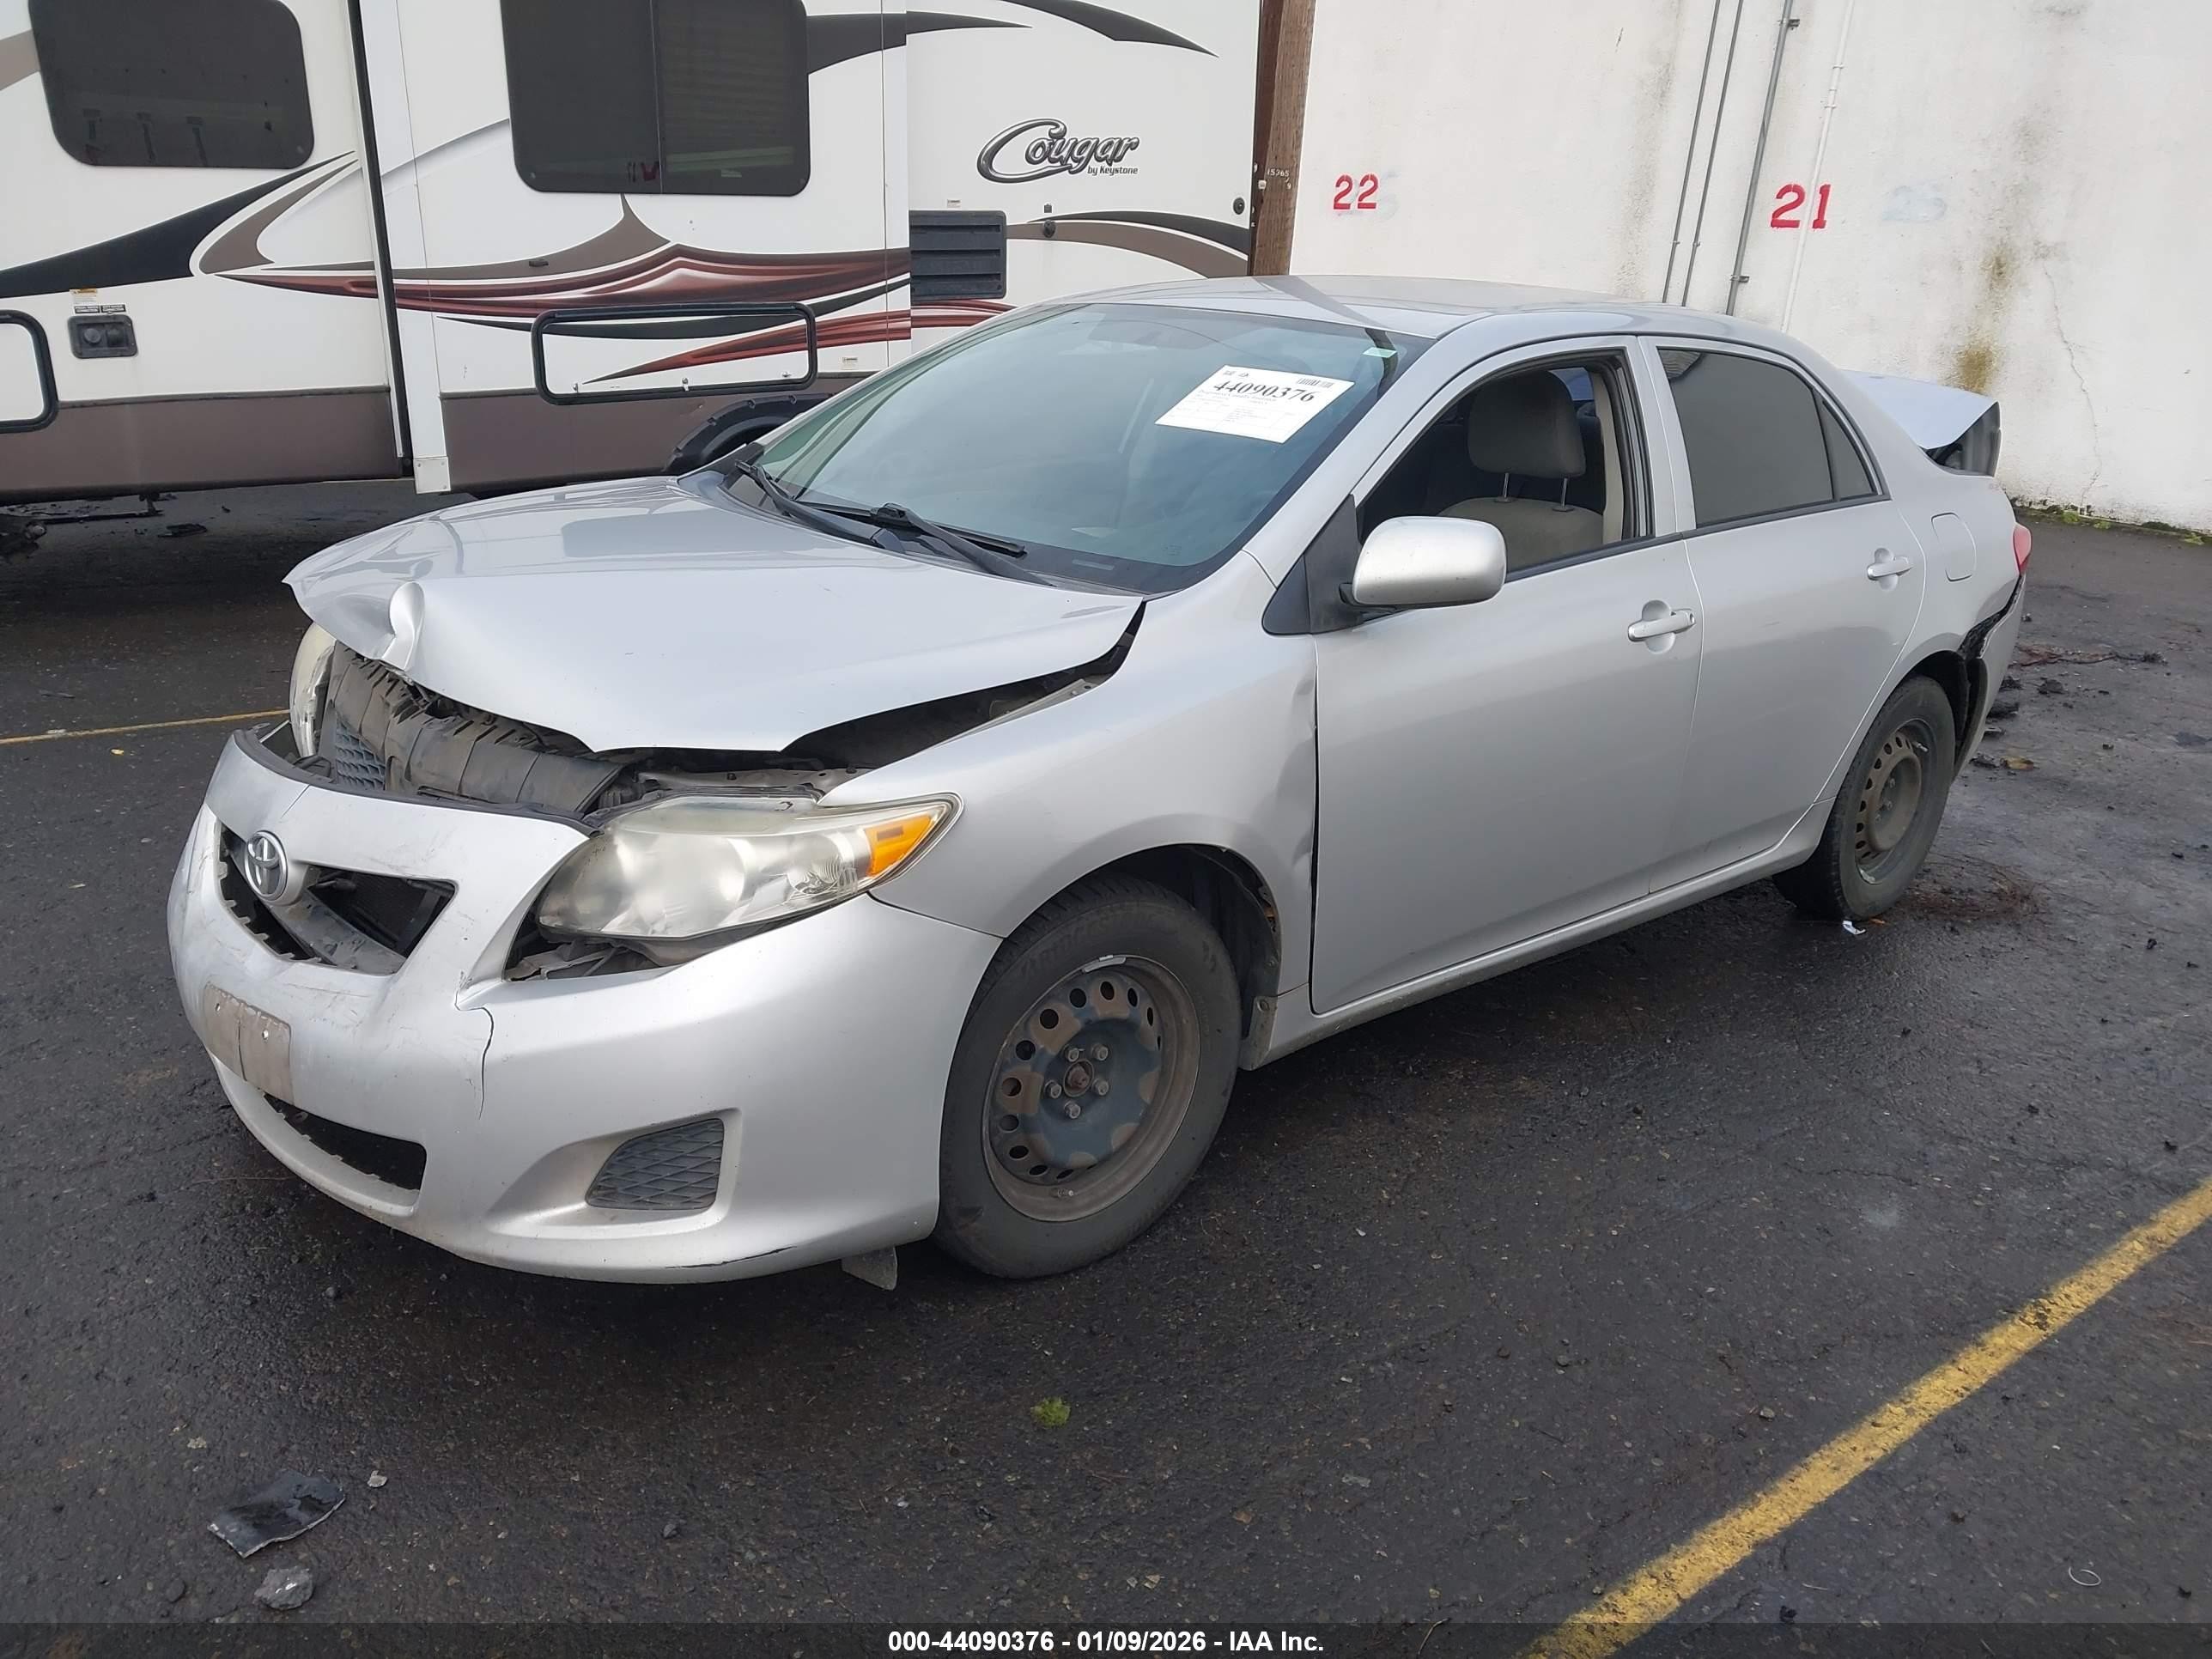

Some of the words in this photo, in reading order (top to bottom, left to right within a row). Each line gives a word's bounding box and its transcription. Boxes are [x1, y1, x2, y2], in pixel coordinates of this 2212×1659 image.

[977, 118, 1139, 183] Cougar
[1087, 165, 1098, 176] by
[1100, 166, 1139, 175] Keystone
[1334, 174, 1378, 210] 22
[1770, 184, 1831, 228] 21
[1213, 380, 1316, 402] 44090376
